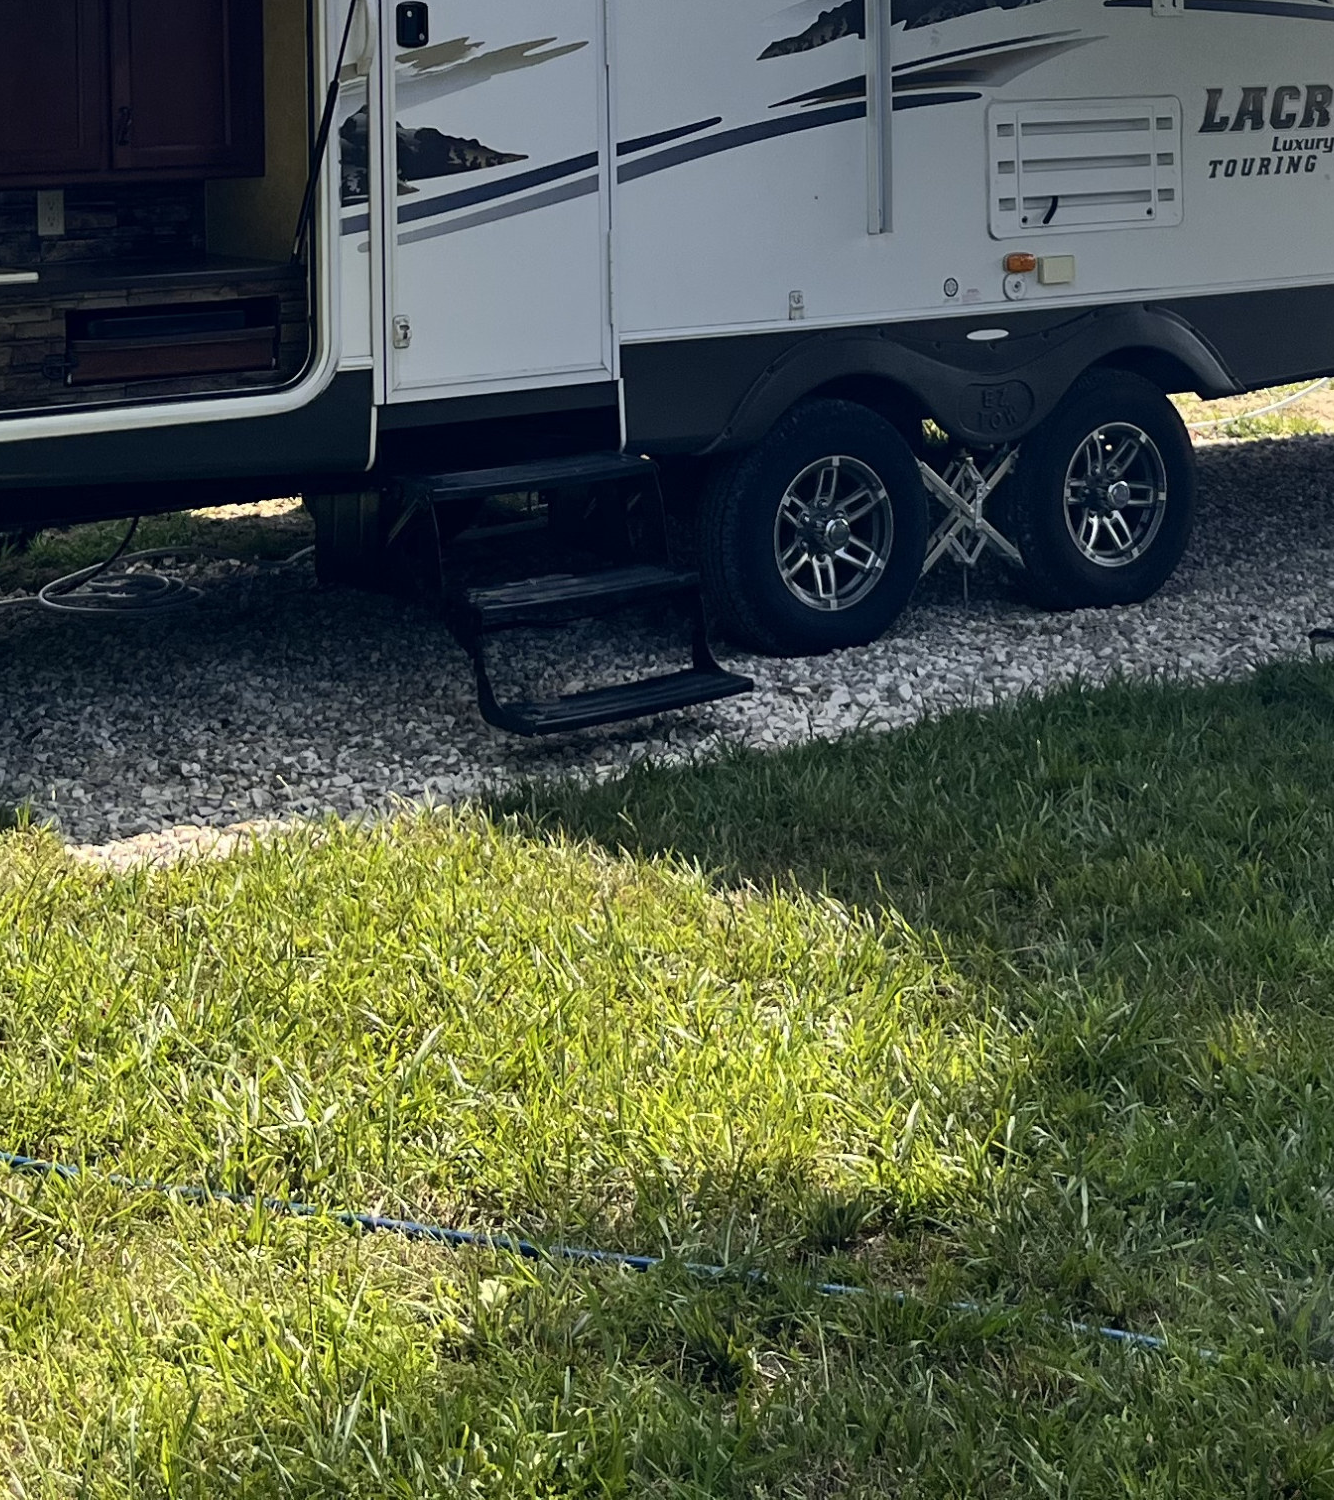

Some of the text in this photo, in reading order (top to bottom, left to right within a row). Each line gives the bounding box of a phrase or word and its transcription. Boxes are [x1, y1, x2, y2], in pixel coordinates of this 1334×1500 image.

[1271, 135, 1334, 153] Luxury
[1208, 154, 1317, 179] TOURING
[982, 387, 1010, 408] EZ
[976, 405, 1017, 430] TOW
